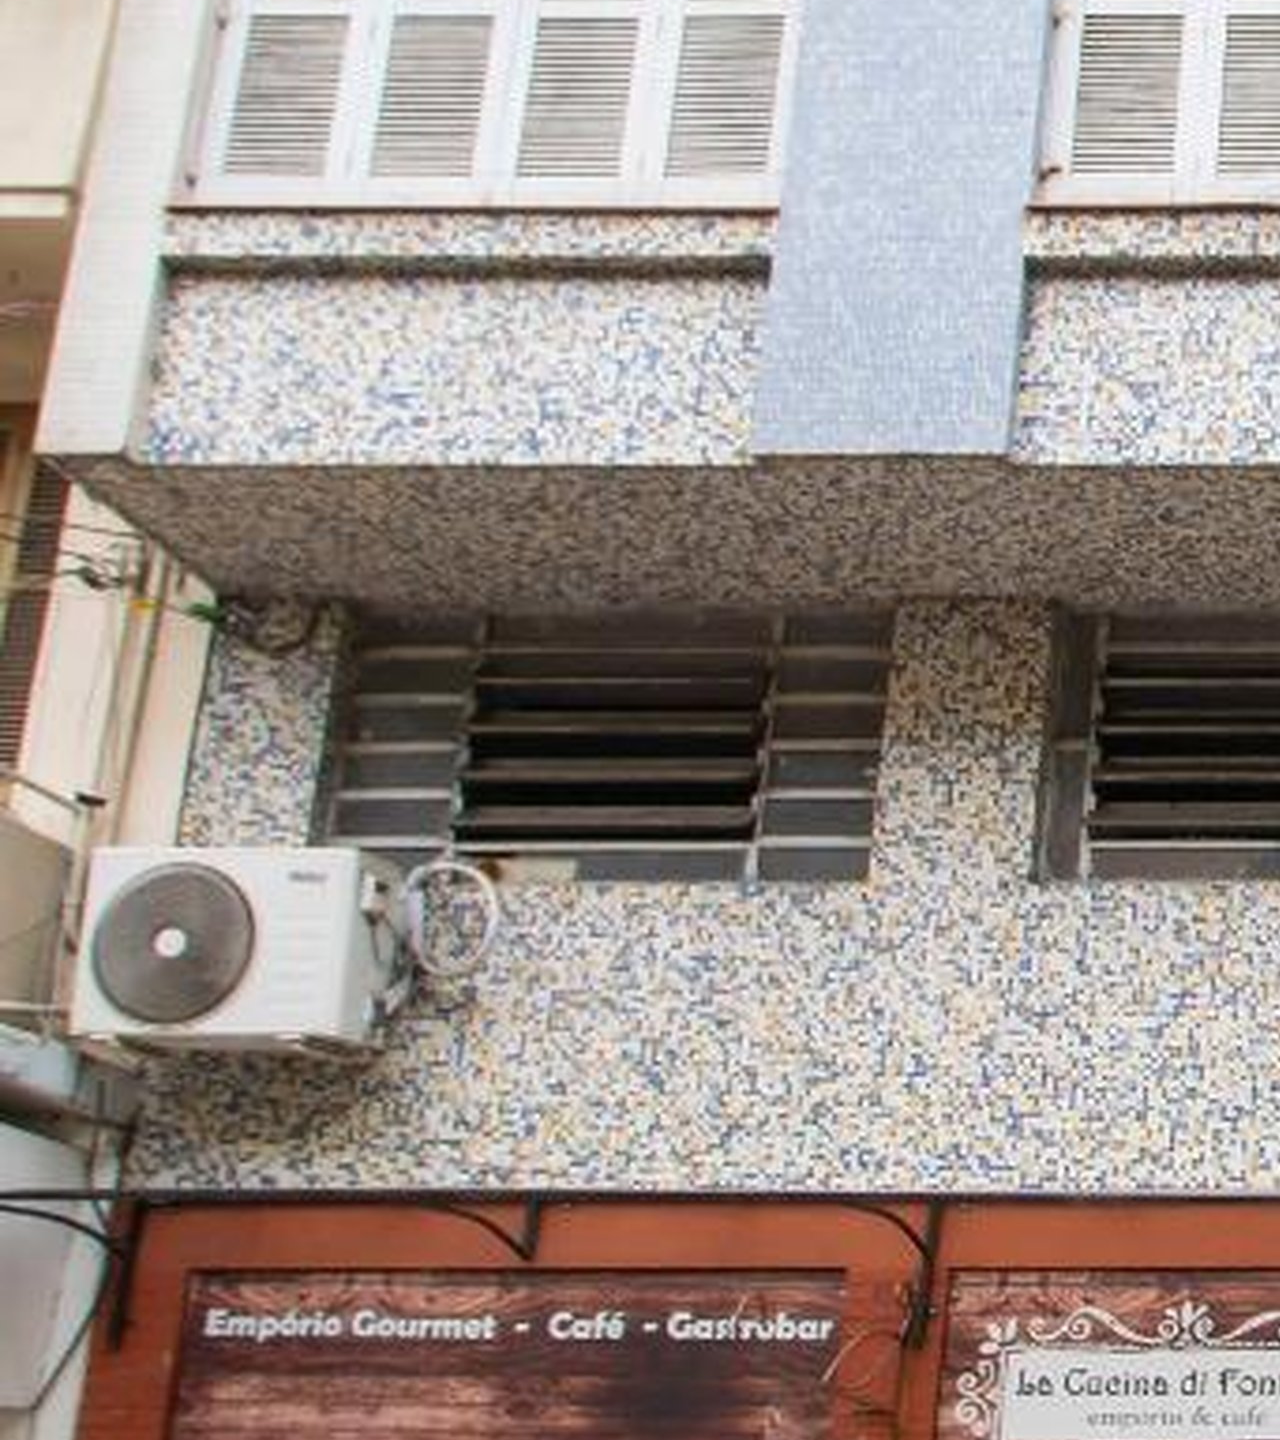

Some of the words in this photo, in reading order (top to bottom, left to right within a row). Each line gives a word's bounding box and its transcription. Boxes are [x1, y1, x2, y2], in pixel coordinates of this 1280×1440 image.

[204, 1305, 342, 1342] Empório
[352, 1309, 497, 1339] Gourmet
[550, 1311, 624, 1340] Café
[1015, 1370, 1054, 1397] La
[1063, 1368, 1168, 1397] Cucina
[1180, 1369, 1208, 1396] di
